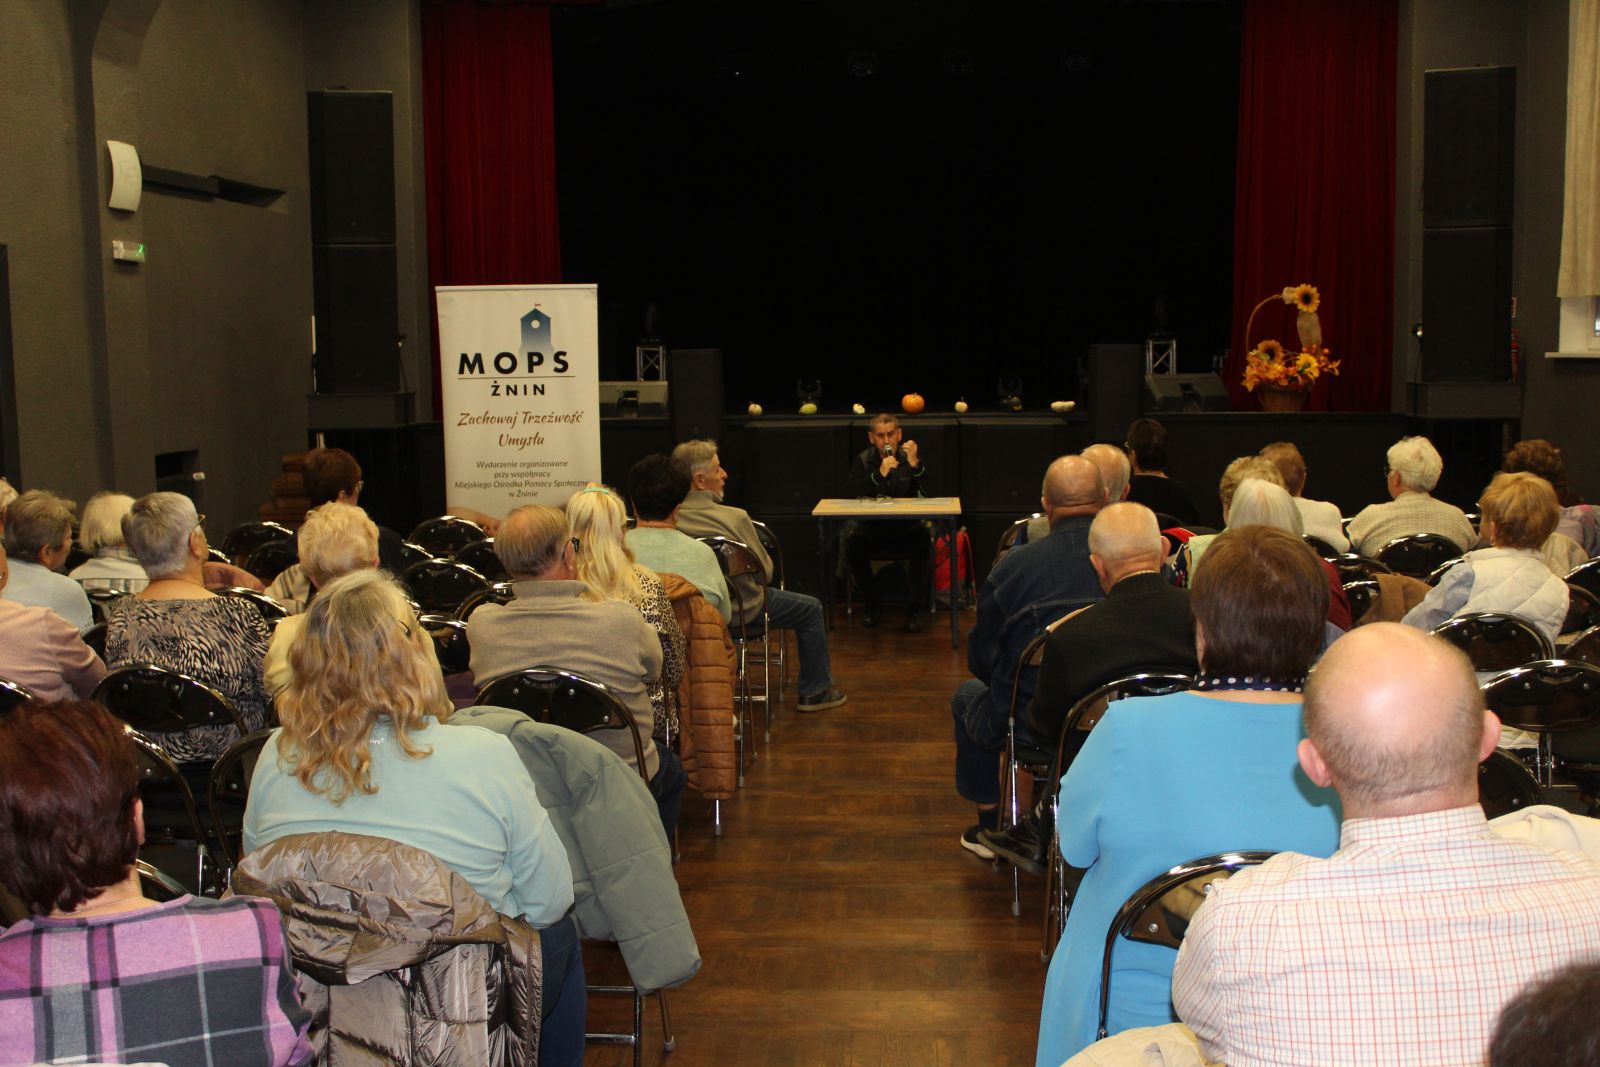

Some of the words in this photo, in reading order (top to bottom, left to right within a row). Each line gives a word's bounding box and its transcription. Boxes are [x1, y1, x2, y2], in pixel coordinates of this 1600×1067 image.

[458, 351, 569, 375] MOPS
[491, 380, 545, 396] ŻNIN
[457, 410, 518, 429] Zachowaj
[522, 410, 584, 424] Trzeźwość
[498, 432, 545, 450] Umysłu
[476, 461, 518, 470] Wydarzenie
[519, 460, 568, 469] organizowane
[511, 470, 551, 479] współpracy
[455, 481, 492, 490] Miejskiego
[493, 480, 522, 488] Ośrodka
[524, 480, 552, 488] Pomocy
[554, 479, 590, 488] Społeczne
[516, 489, 538, 498] Żninie
